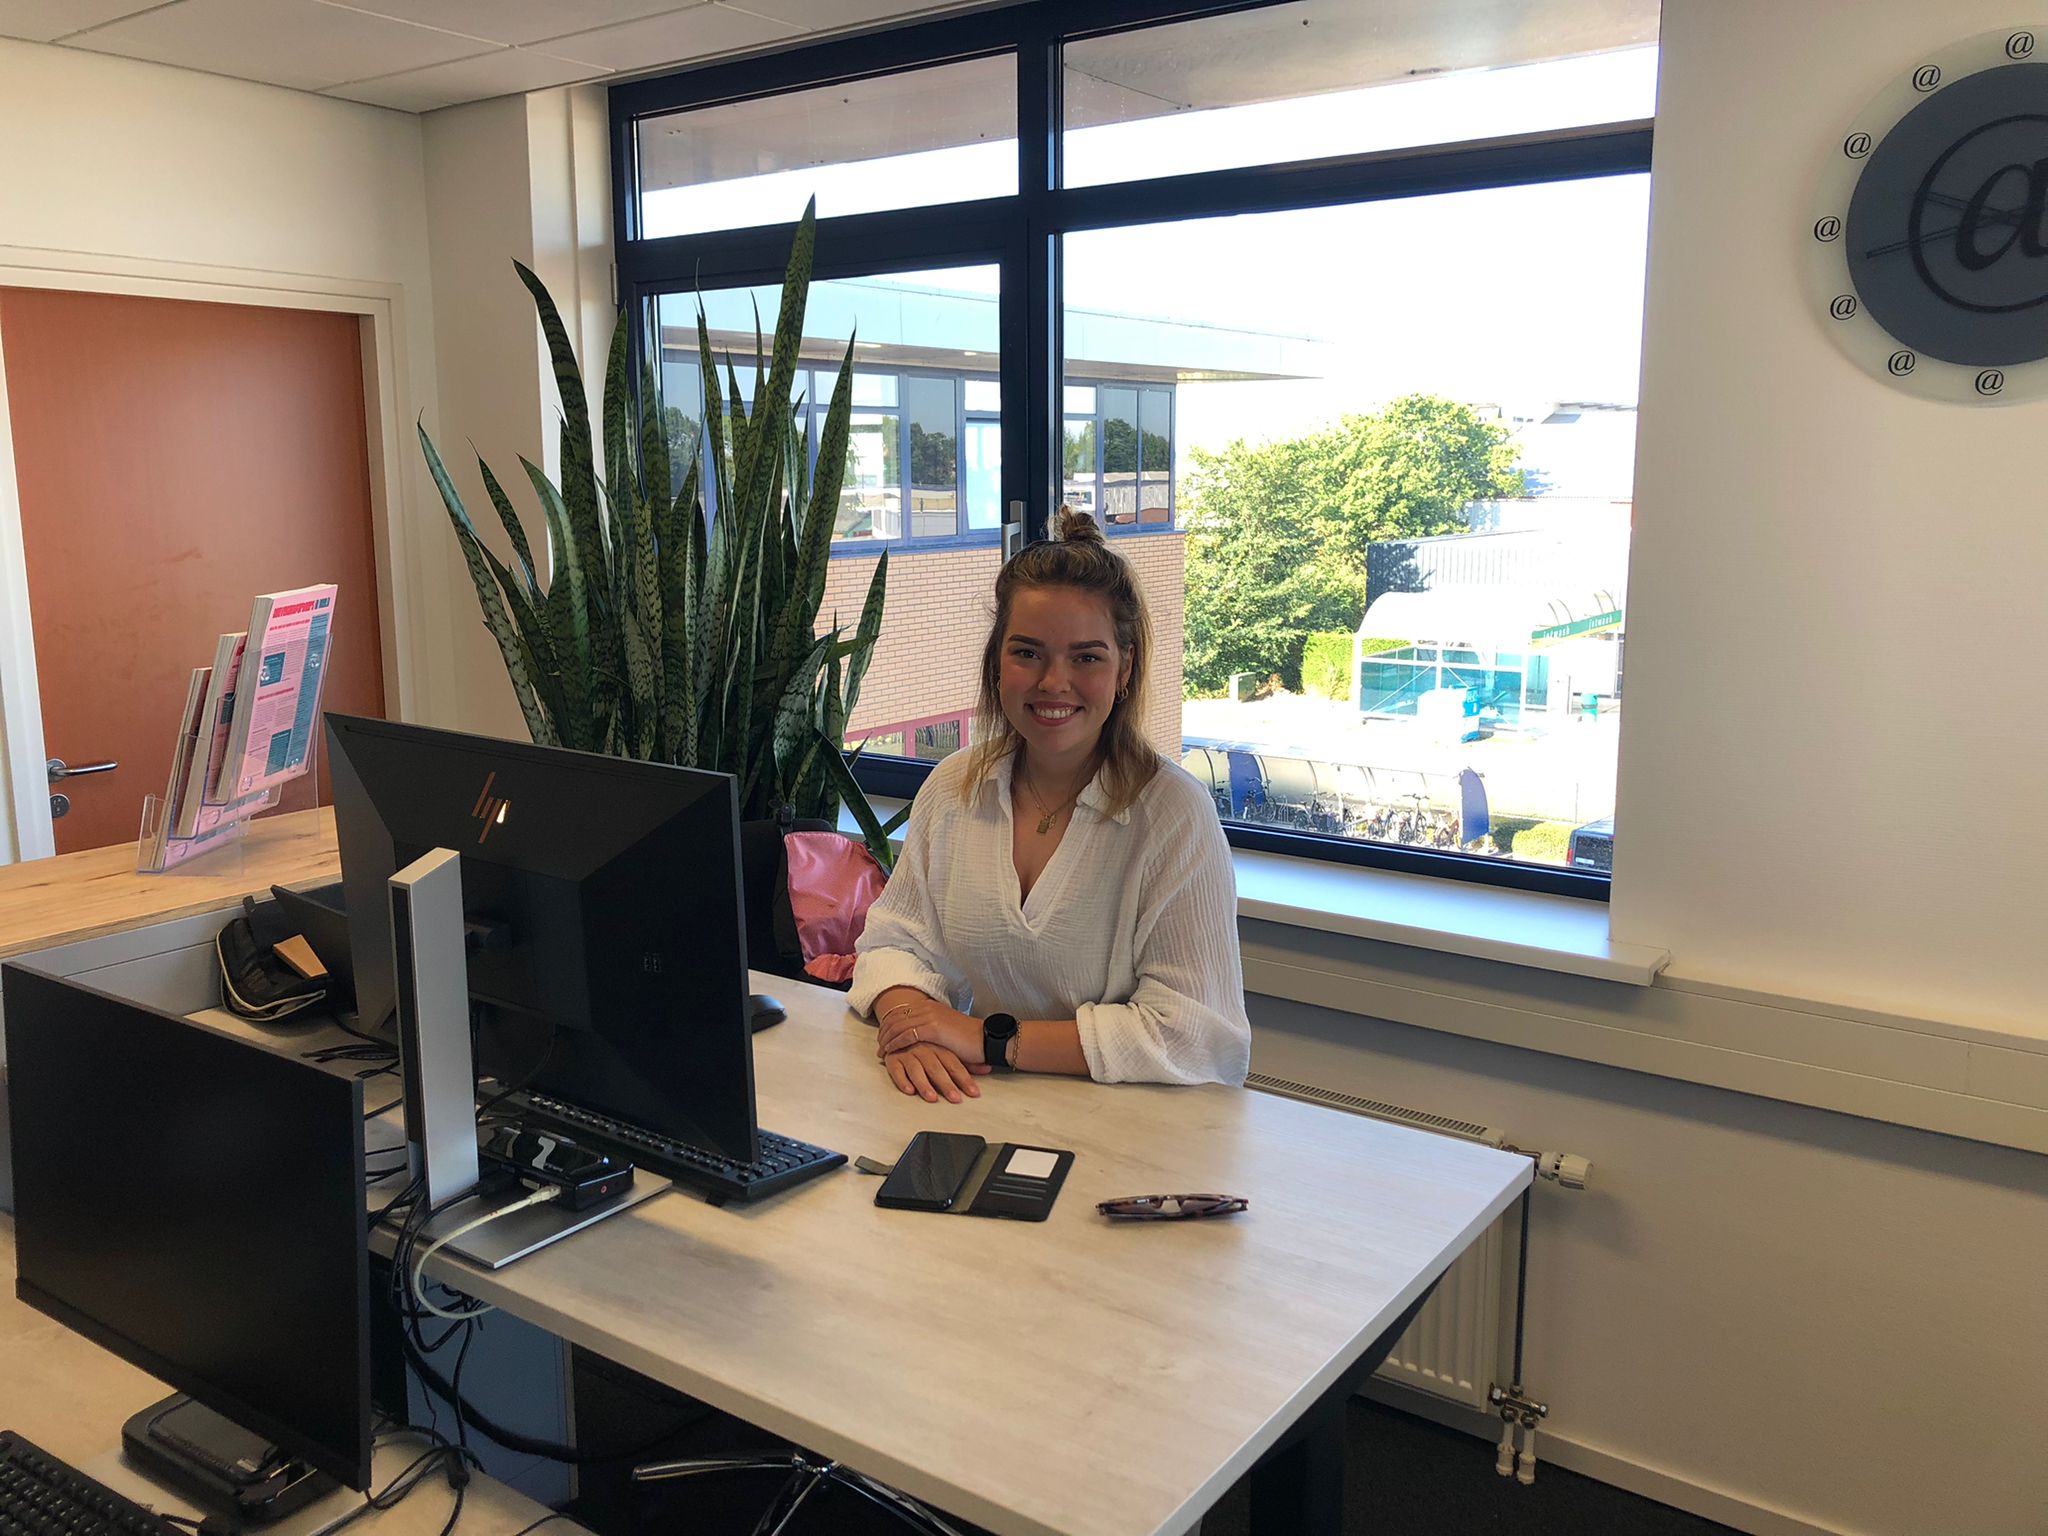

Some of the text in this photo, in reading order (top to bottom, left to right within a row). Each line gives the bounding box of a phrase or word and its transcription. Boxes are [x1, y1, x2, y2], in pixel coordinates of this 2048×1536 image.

[2005, 31, 2035, 60] @
[1912, 64, 1941, 92] @
[1844, 132, 1871, 159] @
[1814, 215, 1841, 243] @
[1830, 294, 1857, 320] @
[1888, 350, 1915, 376] @
[1975, 369, 2004, 395] @
